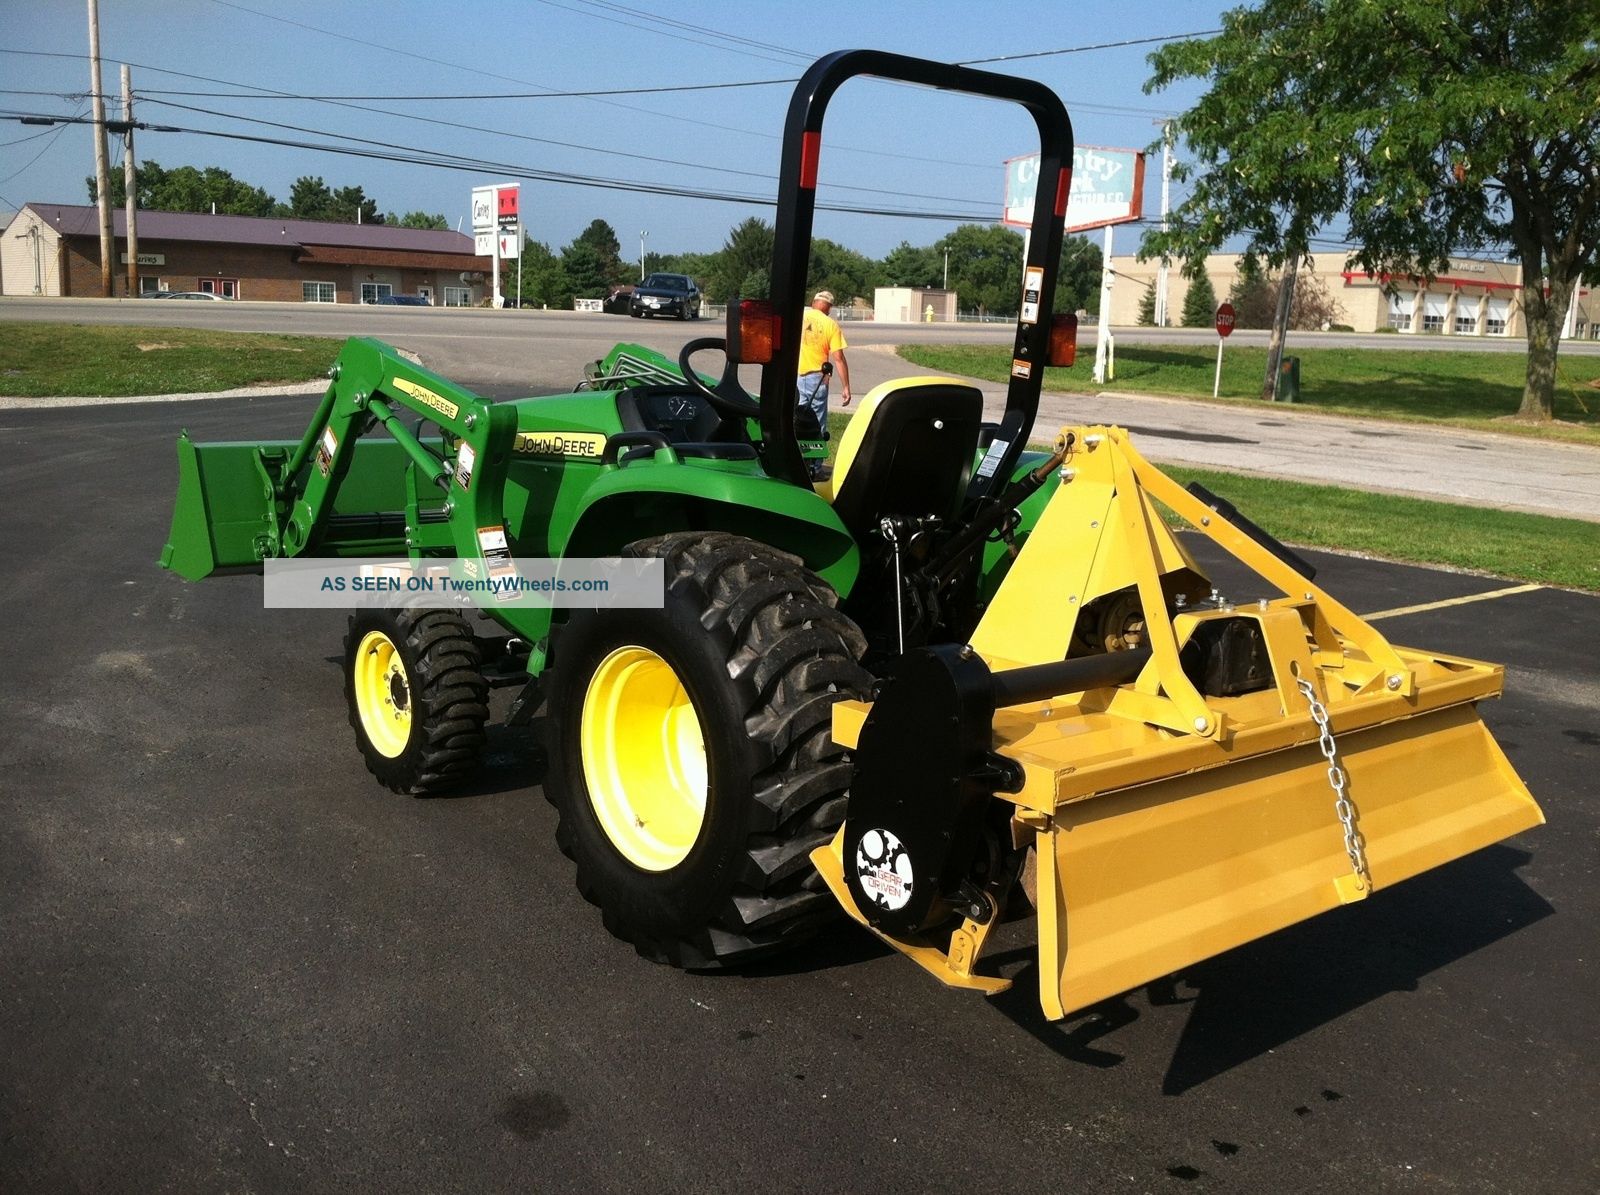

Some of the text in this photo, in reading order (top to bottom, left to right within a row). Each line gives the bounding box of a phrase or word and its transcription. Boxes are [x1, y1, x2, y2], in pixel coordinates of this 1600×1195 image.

[1217, 313, 1234, 326] STOP
[409, 384, 455, 417] JOHN DEERE
[519, 435, 596, 454] JOHN DEERE
[877, 869, 902, 887] GEAR
[868, 877, 902, 899] DRIVEN
